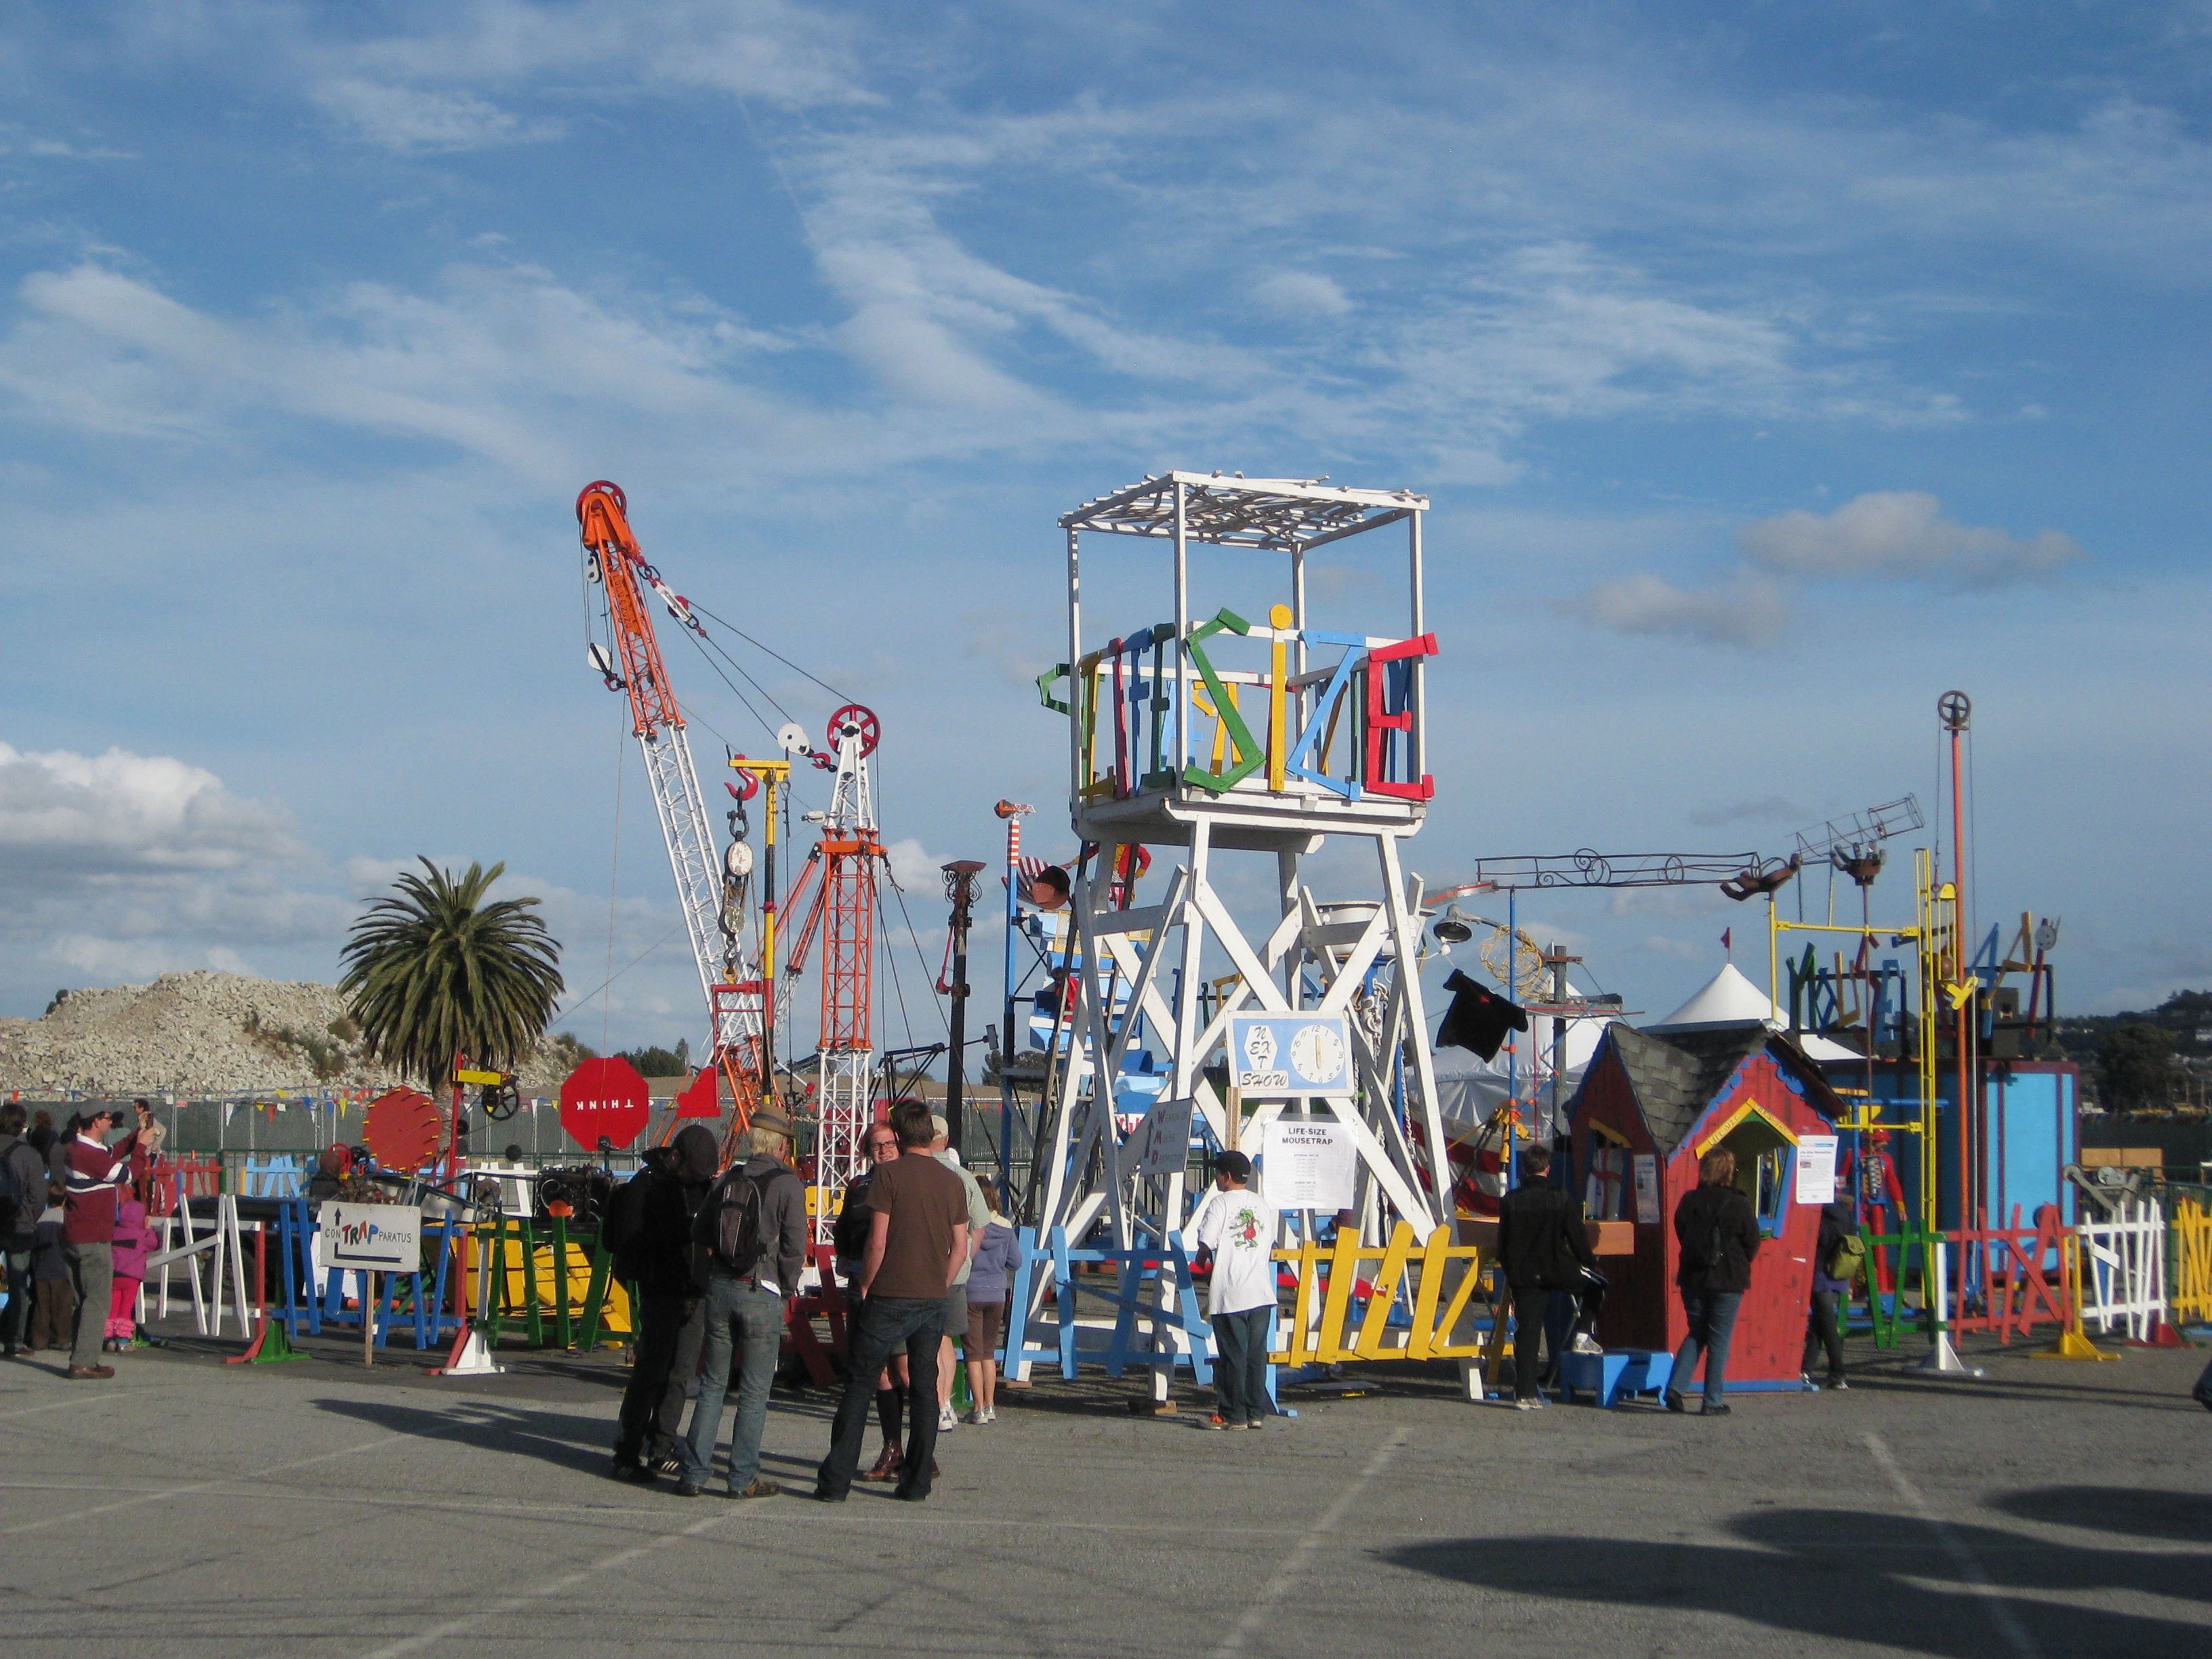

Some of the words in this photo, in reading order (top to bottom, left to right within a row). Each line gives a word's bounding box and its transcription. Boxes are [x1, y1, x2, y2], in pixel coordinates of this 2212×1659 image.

[1242, 1073, 1287, 1087] SHOW
[576, 1099, 634, 1111] THINK
[1288, 1128, 1327, 1136] LIFE-SIZE
